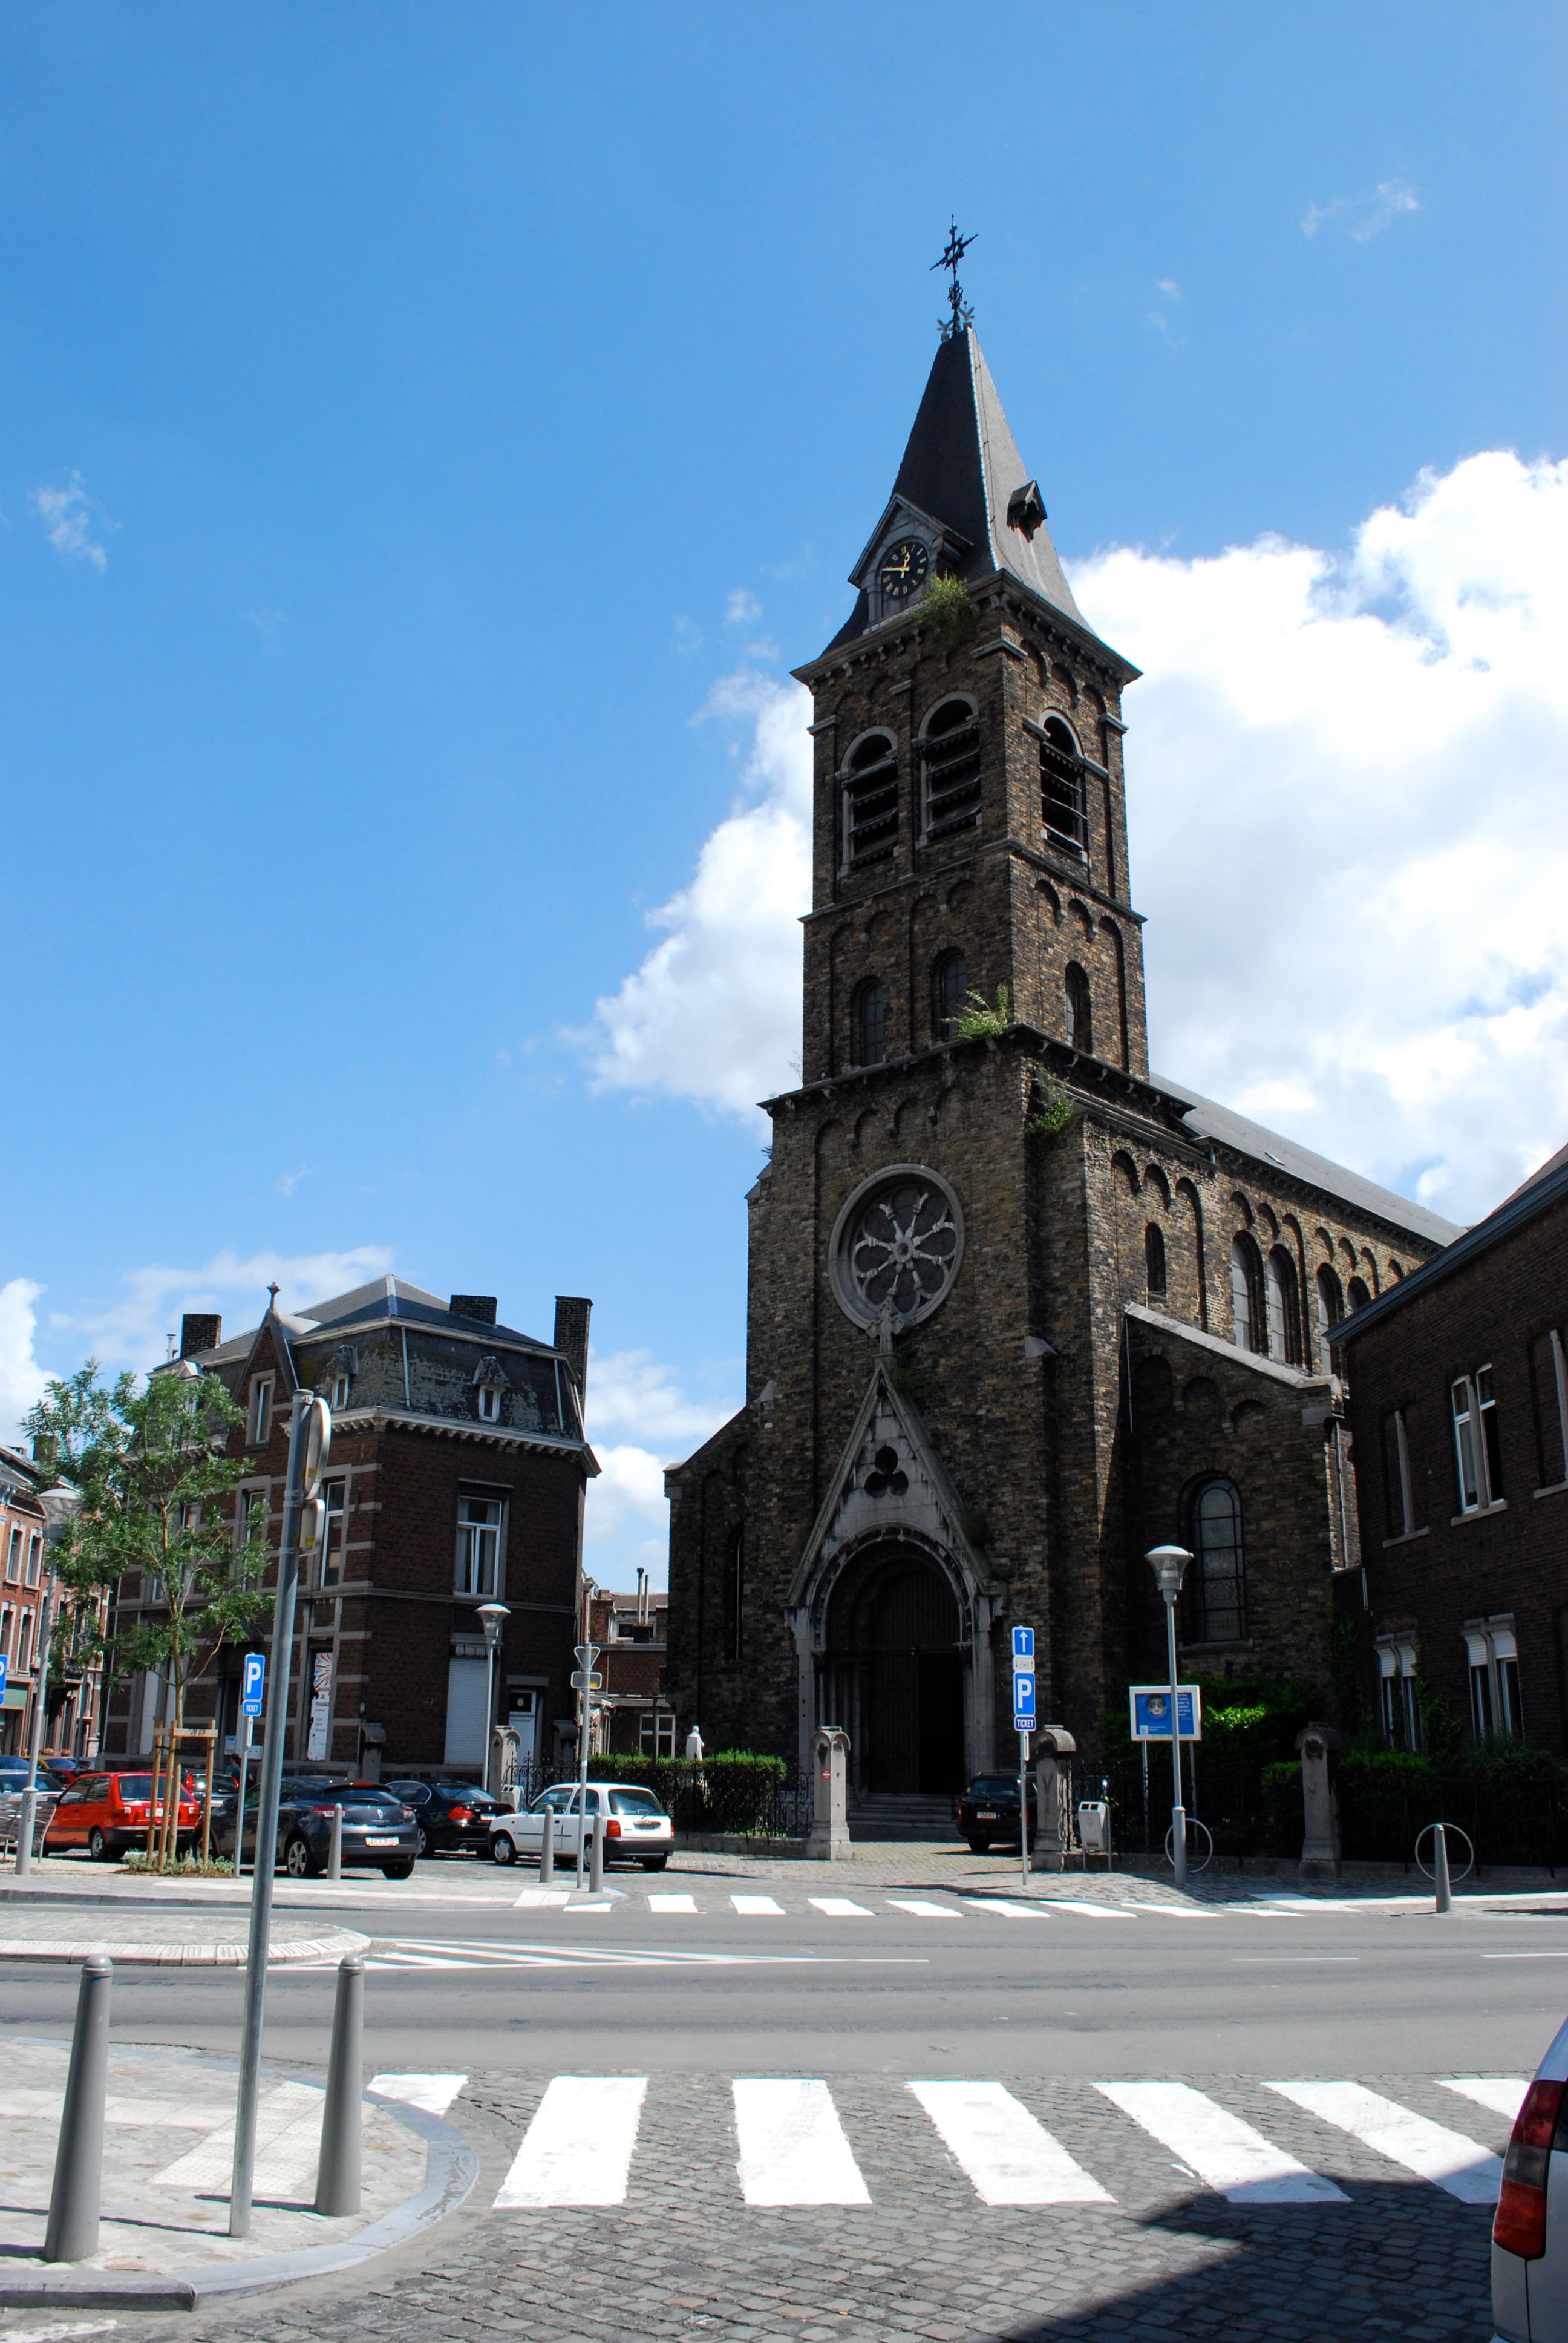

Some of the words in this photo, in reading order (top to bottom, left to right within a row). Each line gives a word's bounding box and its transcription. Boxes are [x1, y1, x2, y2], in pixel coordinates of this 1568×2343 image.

[246, 1662, 261, 1694] P
[1017, 1679, 1032, 1709] P
[1016, 1719, 1034, 1728] TICKET
